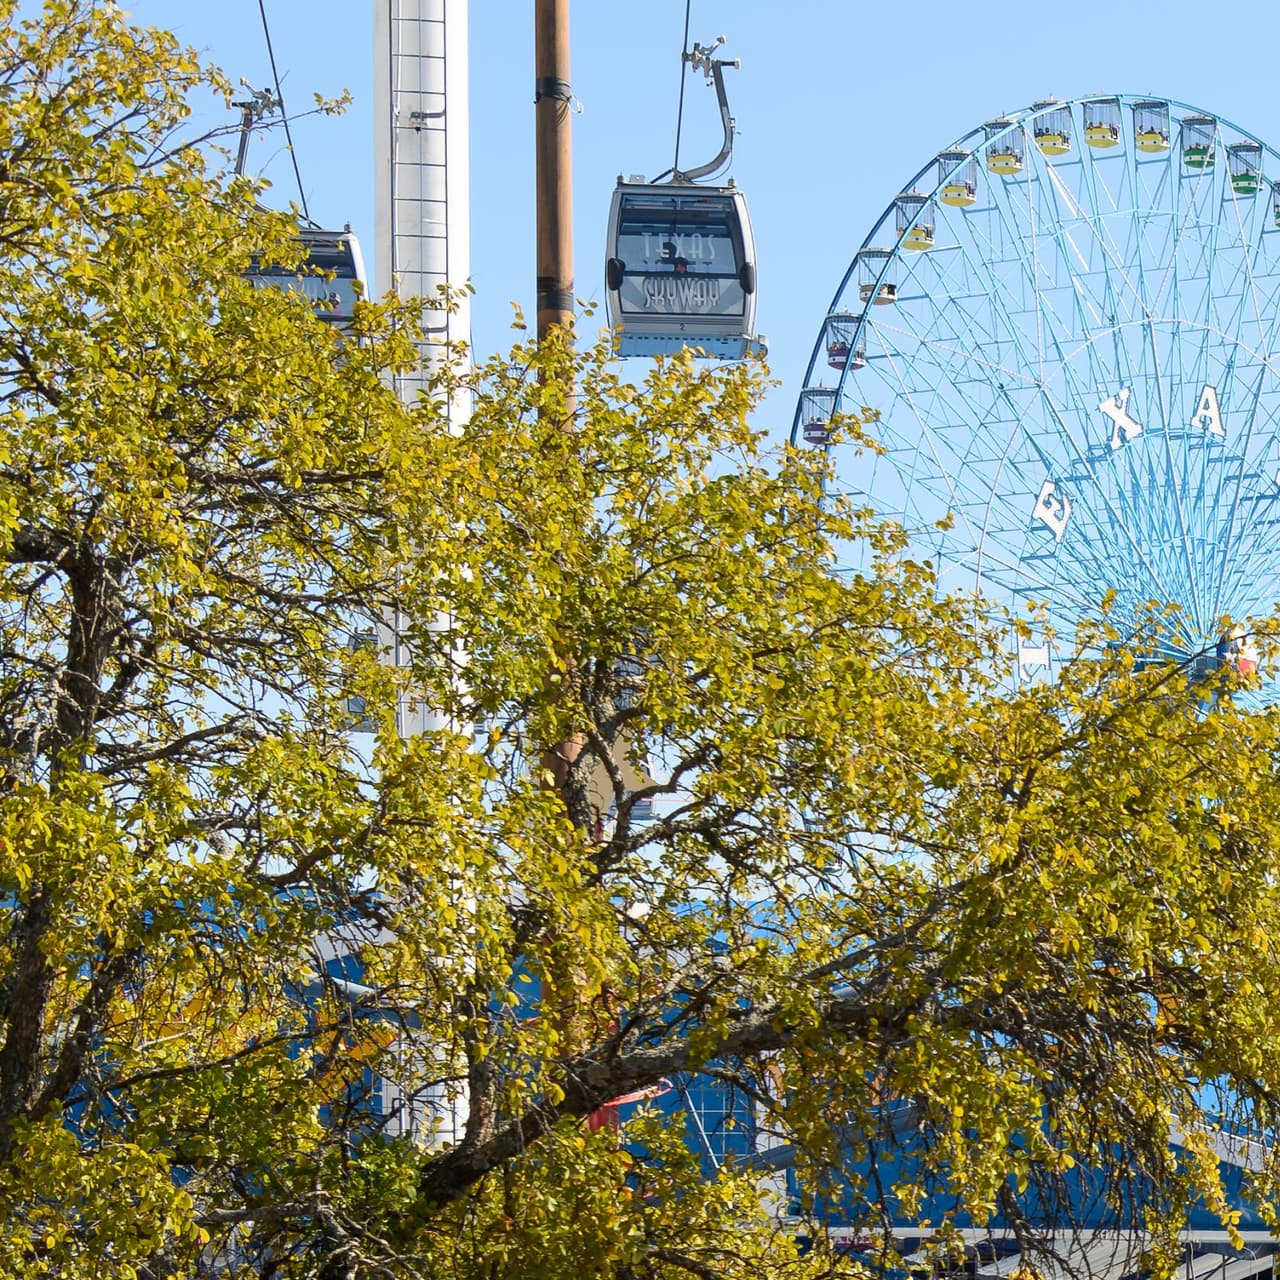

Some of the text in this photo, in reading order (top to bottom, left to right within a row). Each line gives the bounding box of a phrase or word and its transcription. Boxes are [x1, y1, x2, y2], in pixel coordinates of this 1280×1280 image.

[641, 232, 716, 259] TEXAS
[642, 278, 720, 308] SKYWAY
[680, 323, 685, 331] 2
